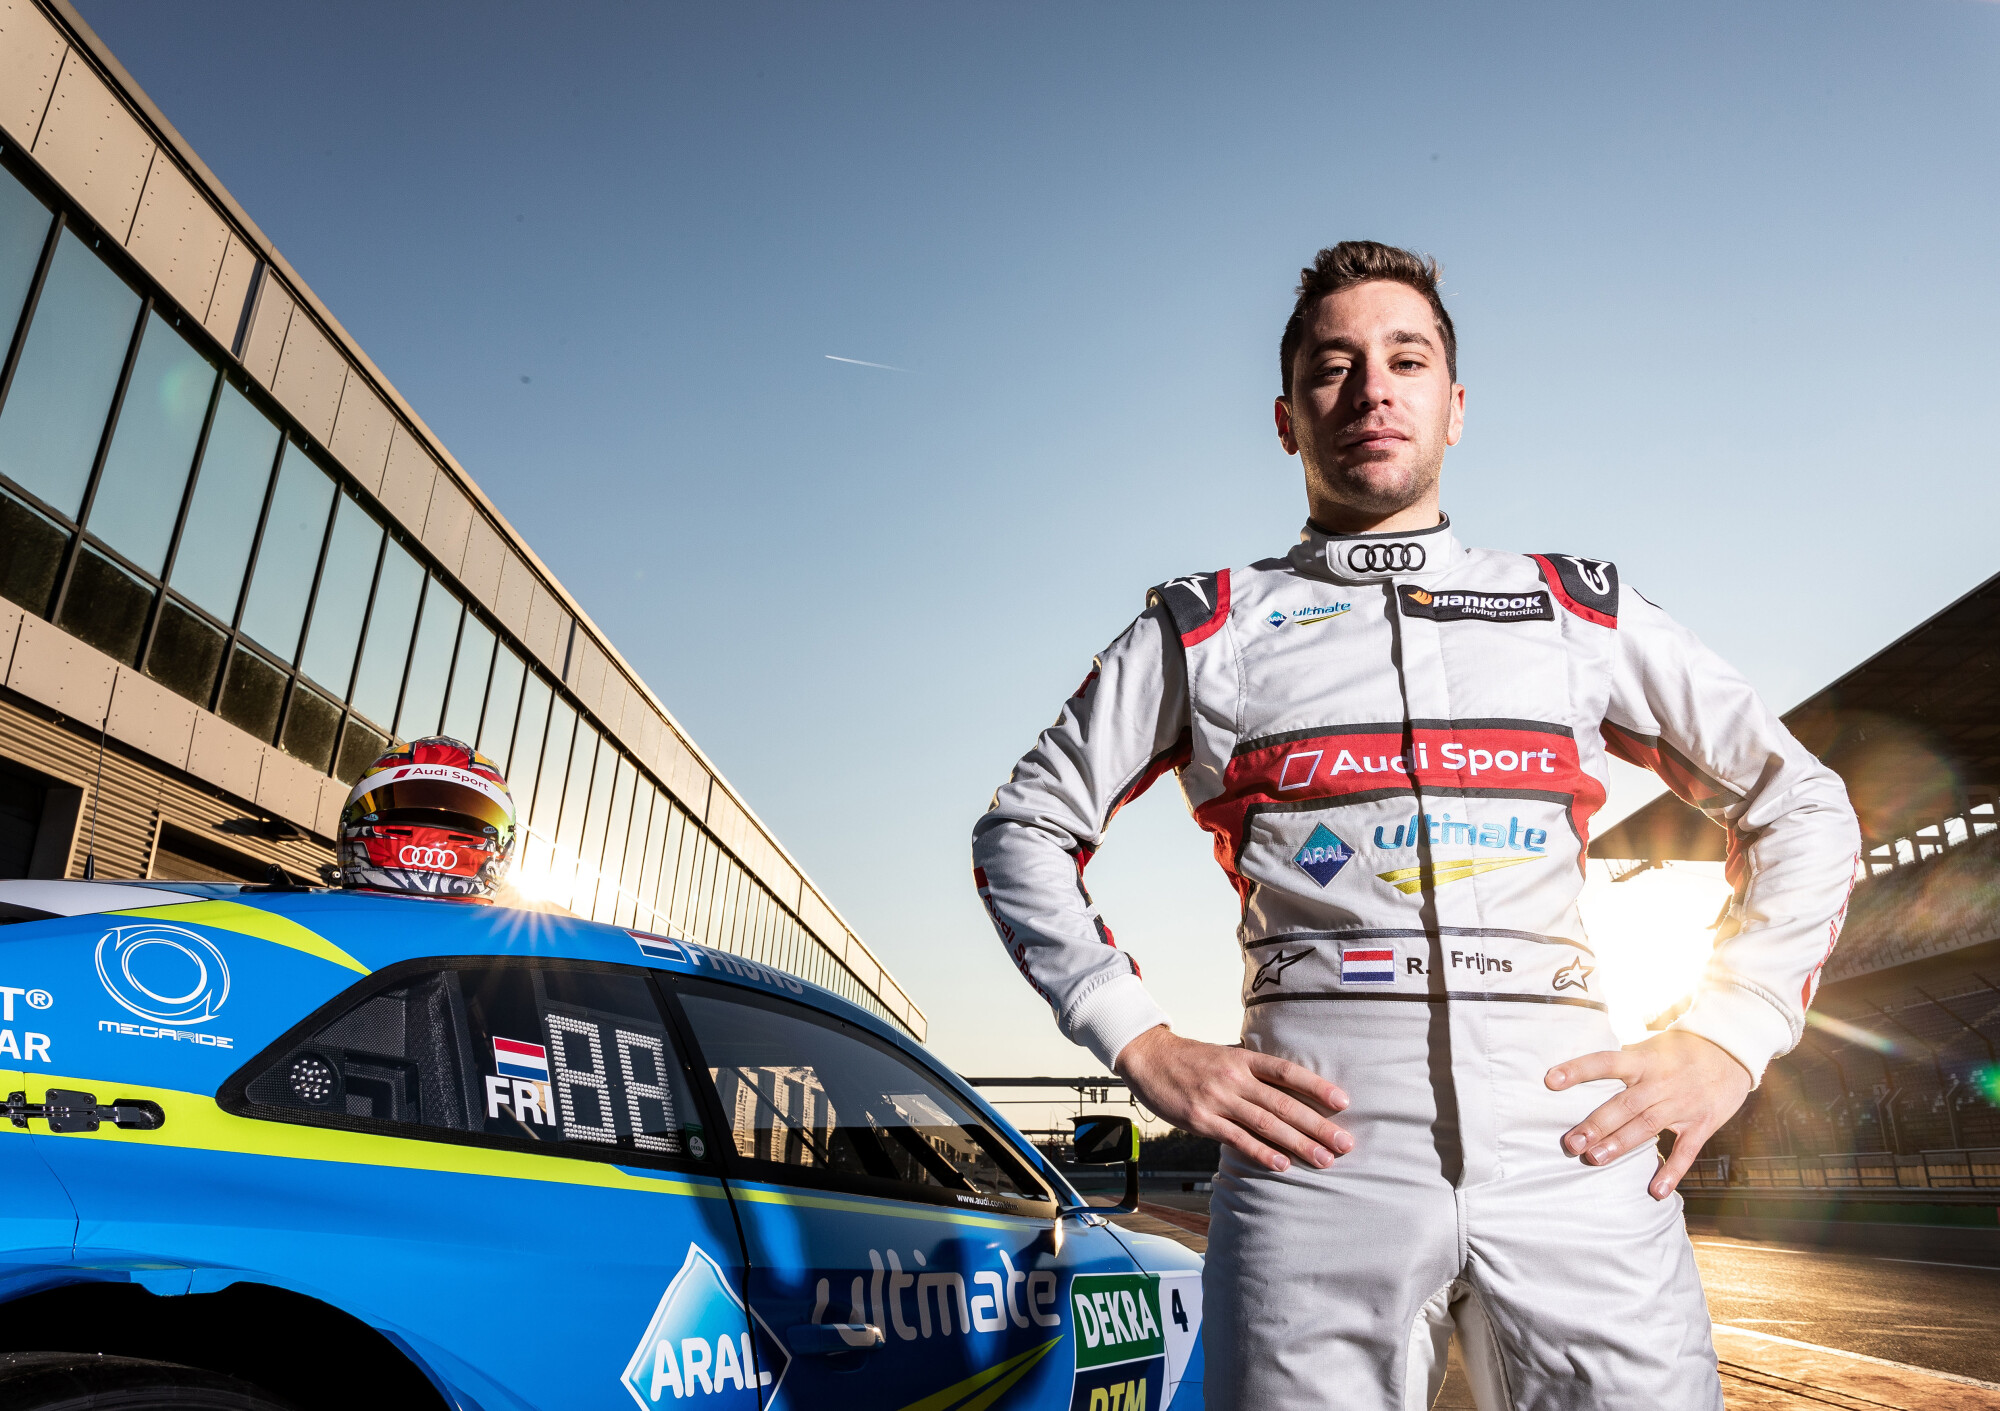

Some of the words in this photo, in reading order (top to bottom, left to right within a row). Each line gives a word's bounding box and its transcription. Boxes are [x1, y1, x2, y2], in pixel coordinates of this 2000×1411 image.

[1293, 602, 1351, 616] ultimate
[1462, 606, 1496, 618] driving
[1499, 607, 1543, 617] emotion
[1330, 743, 1428, 776] Audi
[1440, 743, 1556, 776] Sport
[412, 767, 447, 776] Audi
[452, 771, 489, 791] Sport
[1373, 813, 1547, 852] ultimate
[1300, 844, 1348, 866] ARAL
[1406, 957, 1432, 975] R.
[1450, 950, 1513, 975] Frijns
[98, 1020, 234, 1049] MEGARIDE
[485, 1075, 557, 1127] FRI
[811, 1248, 1061, 1347] ultimate
[1171, 1288, 1189, 1333] 4
[1074, 1288, 1160, 1349] DEKRA
[650, 1331, 773, 1402] ARAL
